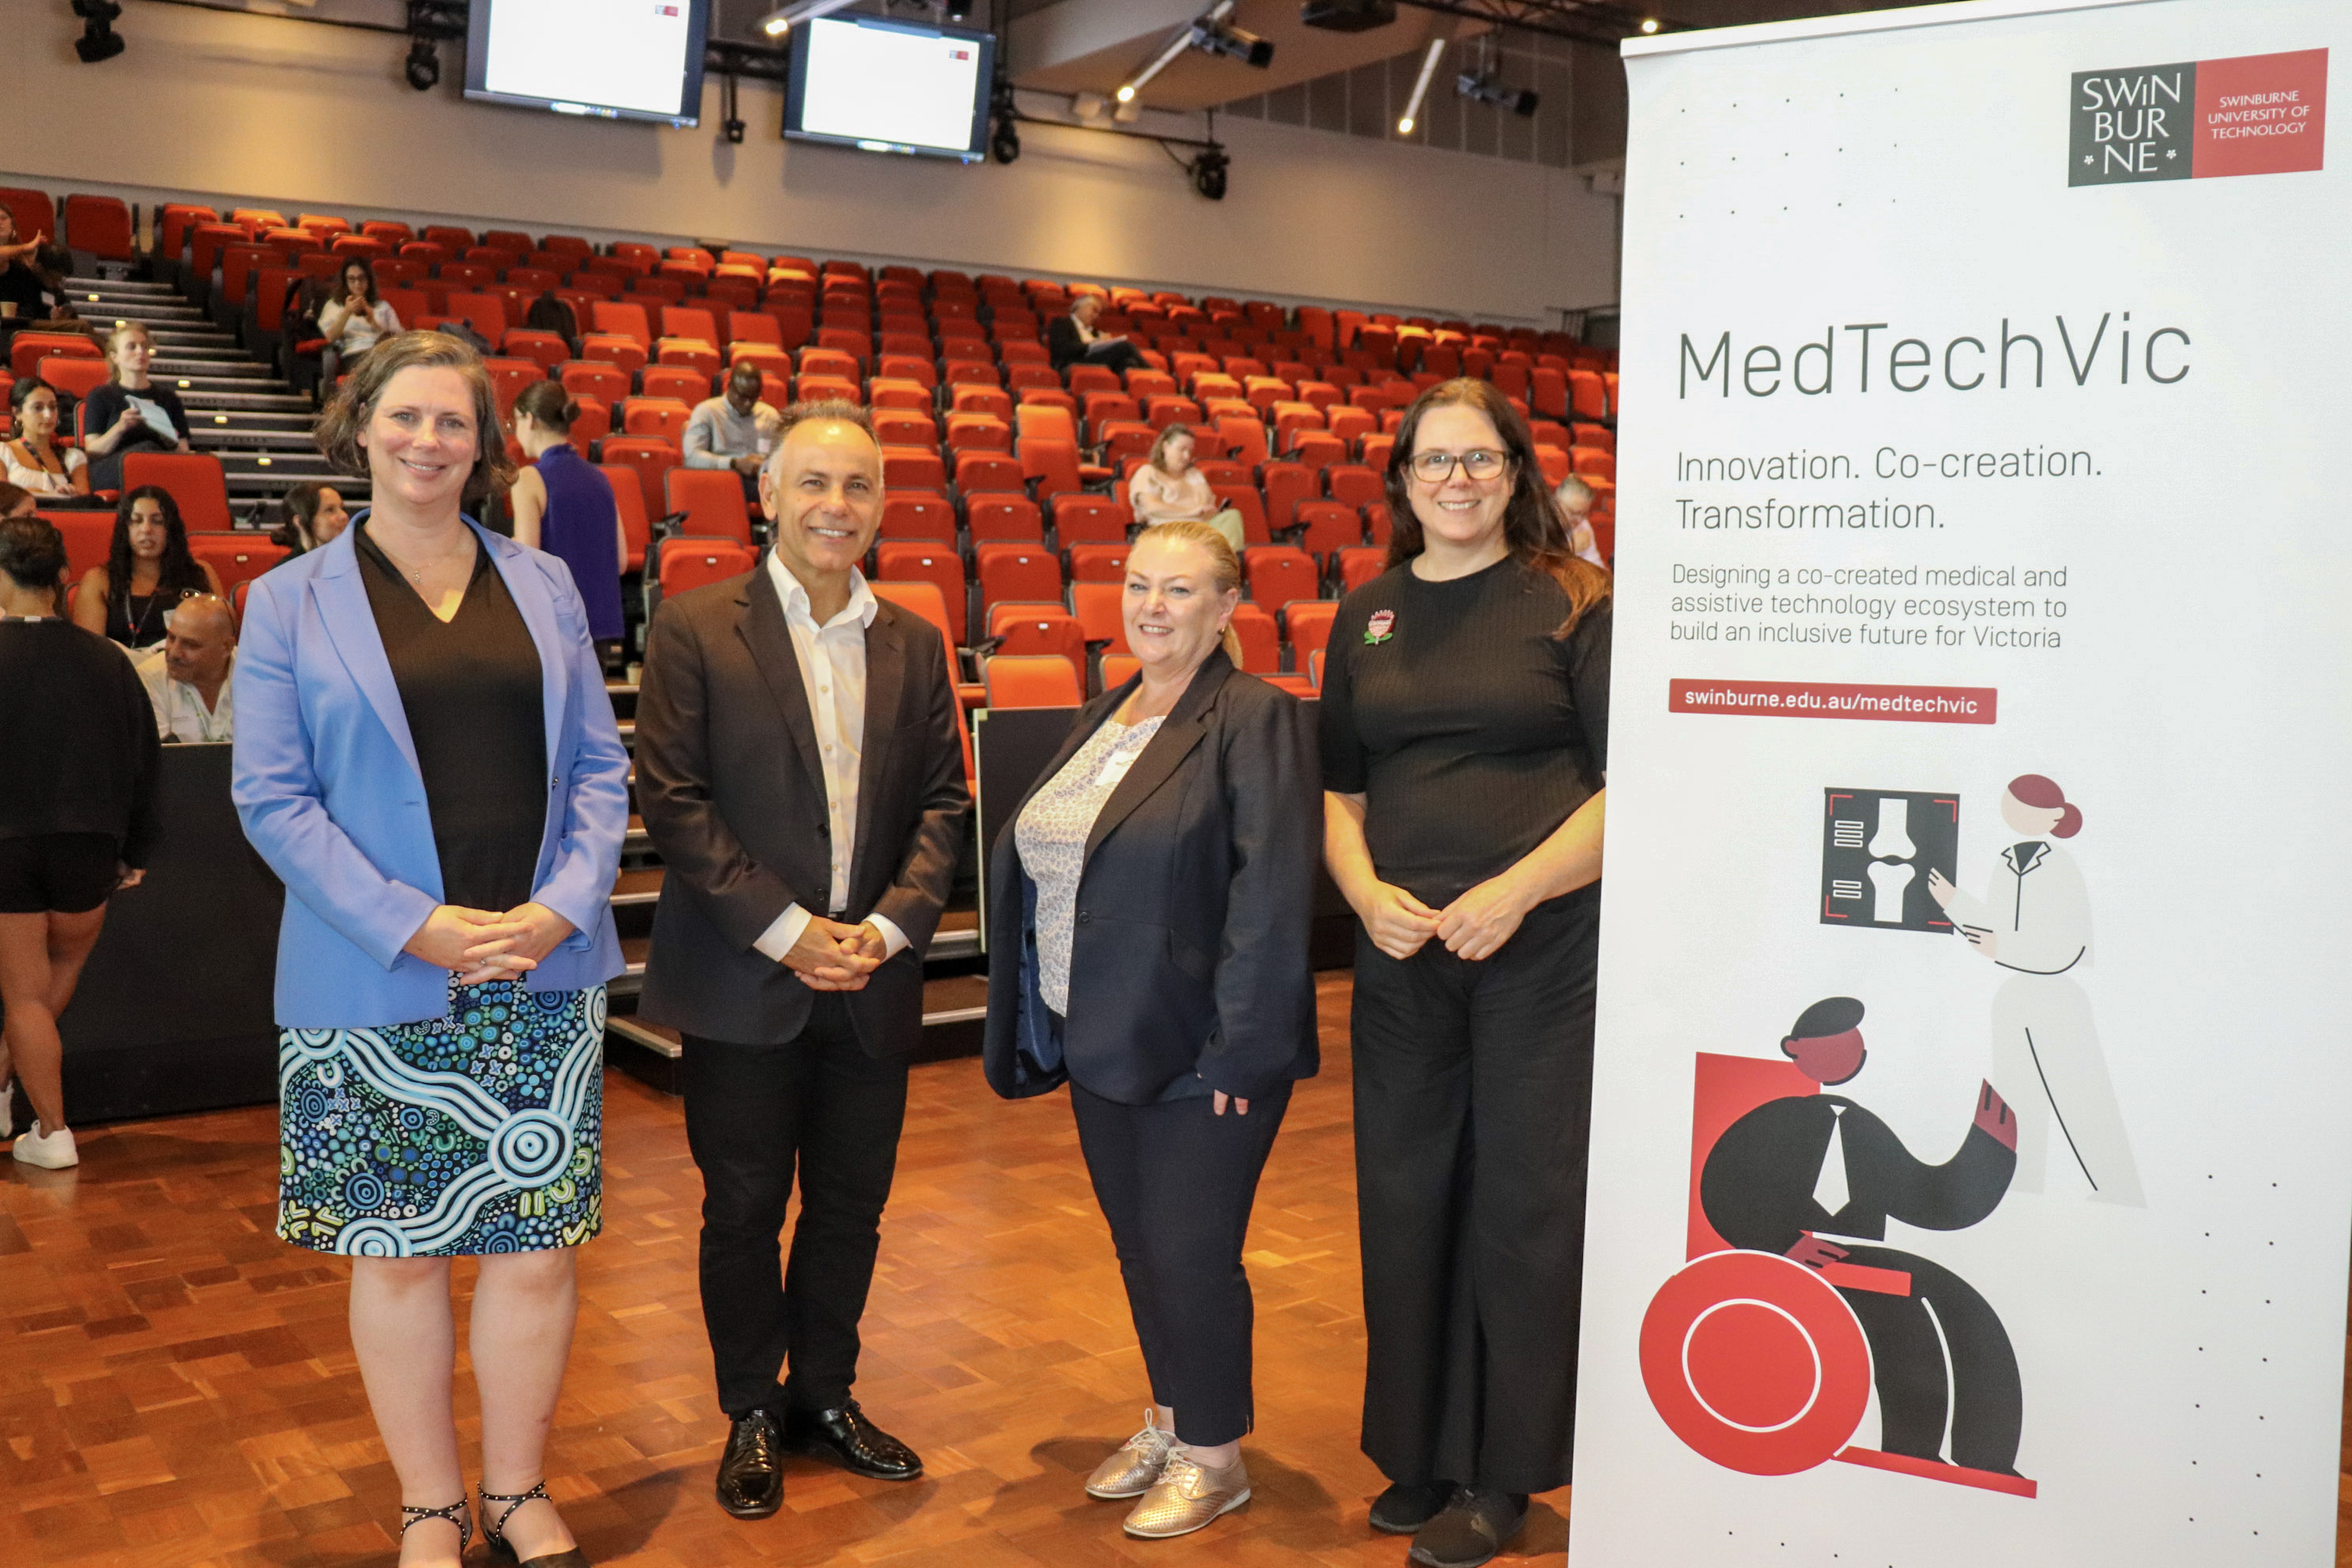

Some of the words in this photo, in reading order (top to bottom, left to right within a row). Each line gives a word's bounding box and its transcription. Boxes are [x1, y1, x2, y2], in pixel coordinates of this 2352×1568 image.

[2218, 89, 2300, 108] SWINBURNE
[2094, 108, 2170, 143] BUR
[2207, 109, 2287, 125] UNIVERSITY
[2290, 104, 2311, 118] OF
[2211, 121, 2307, 140] TECHNOLOGY
[2103, 141, 2158, 175] NE
[1679, 311, 2192, 400] MedTechVic
[1677, 448, 1860, 482] Innovation.
[1875, 443, 2102, 479] Co-creation.
[1674, 496, 1944, 530] Transformation.
[1672, 564, 1770, 590] Designing
[1777, 568, 1790, 585] a
[1797, 564, 1917, 586] co-created
[1925, 564, 2016, 587] medical
[2023, 565, 2067, 587] and
[1671, 592, 1763, 613] assistive
[1770, 594, 1897, 620] technology
[1904, 598, 2035, 621] ecosystem
[2044, 597, 2067, 618] to
[1670, 620, 1718, 642] build
[1724, 625, 1751, 642] an
[1758, 621, 1852, 644] inclusive
[1859, 623, 1928, 646] future
[1935, 624, 1966, 646] for
[1973, 625, 2061, 649] Victoria
[1684, 688, 1978, 714] swinburne.edu.au/medtechvic
